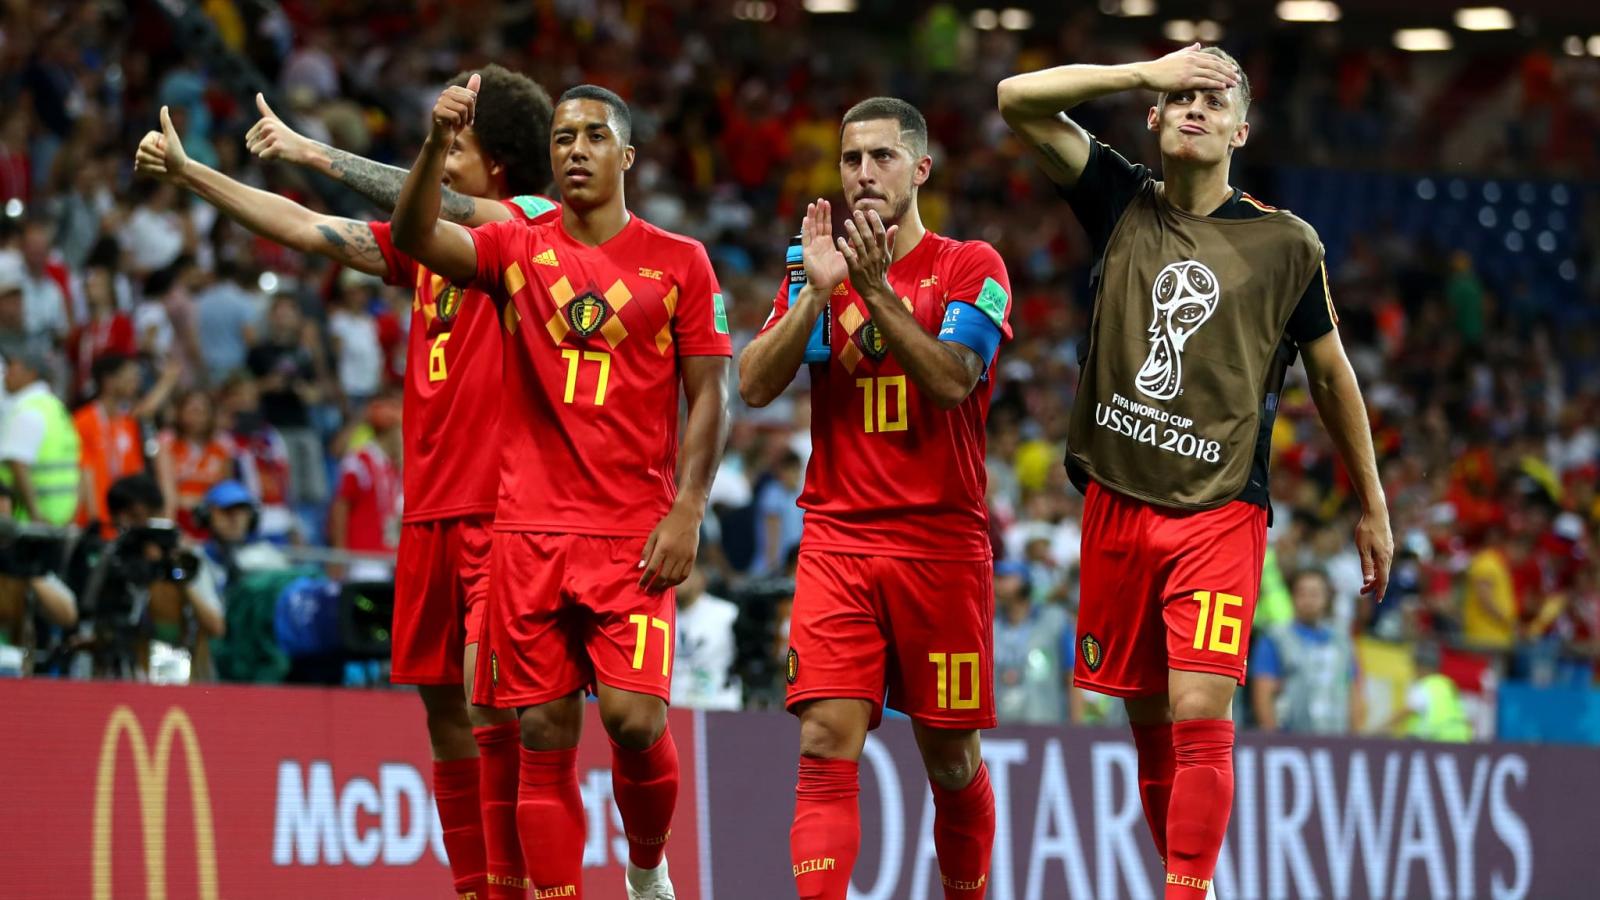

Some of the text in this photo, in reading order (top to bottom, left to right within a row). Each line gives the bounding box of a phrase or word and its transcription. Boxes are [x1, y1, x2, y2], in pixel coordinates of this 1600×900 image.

[429, 333, 451, 382] 6
[561, 348, 611, 407] 17
[856, 375, 908, 433] 10
[1112, 393, 1194, 429] FIFA WORLD CUP
[1158, 428, 1221, 463] 2018
[629, 614, 670, 678] 17
[1192, 591, 1243, 656] 16
[928, 652, 980, 710] 10
